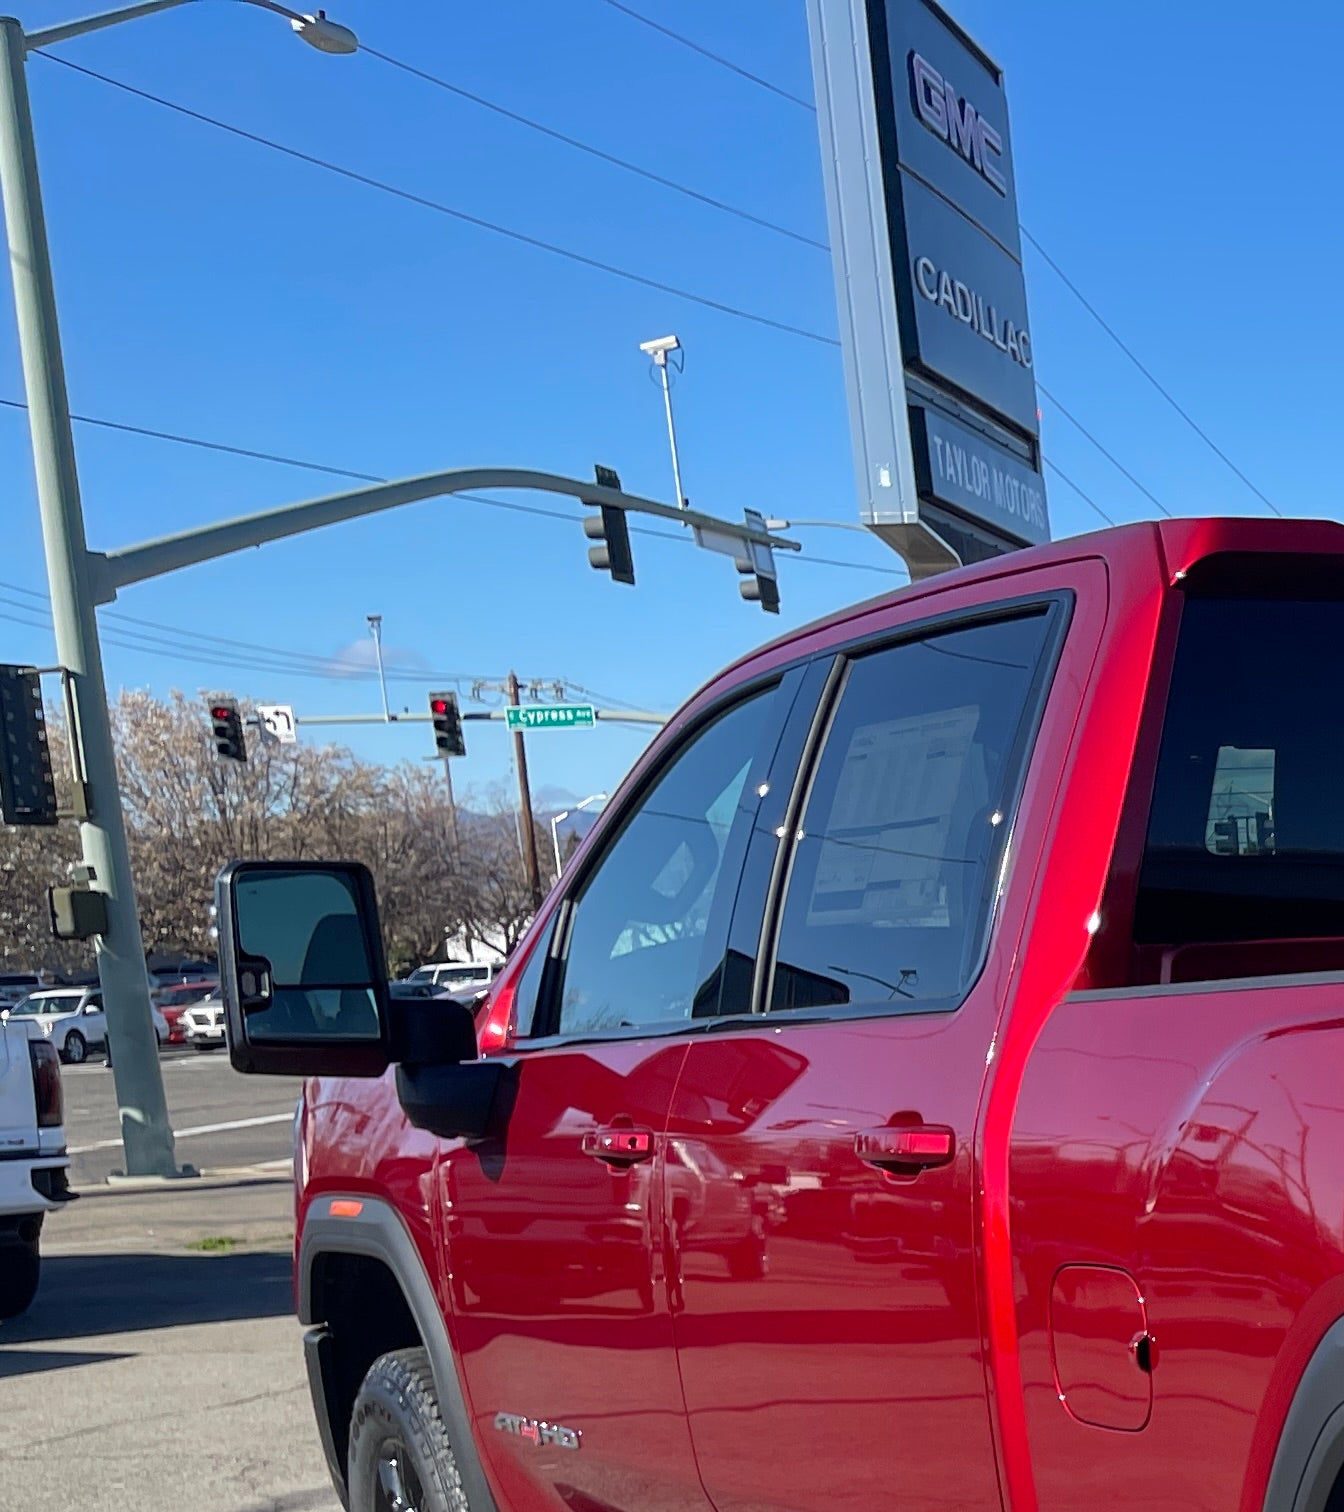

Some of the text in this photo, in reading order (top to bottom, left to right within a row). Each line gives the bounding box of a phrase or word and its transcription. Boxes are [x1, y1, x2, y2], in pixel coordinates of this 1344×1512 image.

[908, 48, 1006, 198] GMC
[914, 255, 1033, 369] CADILLAC
[933, 435, 1045, 530] TAYLOR MOTORS
[519, 709, 573, 725] Cypress
